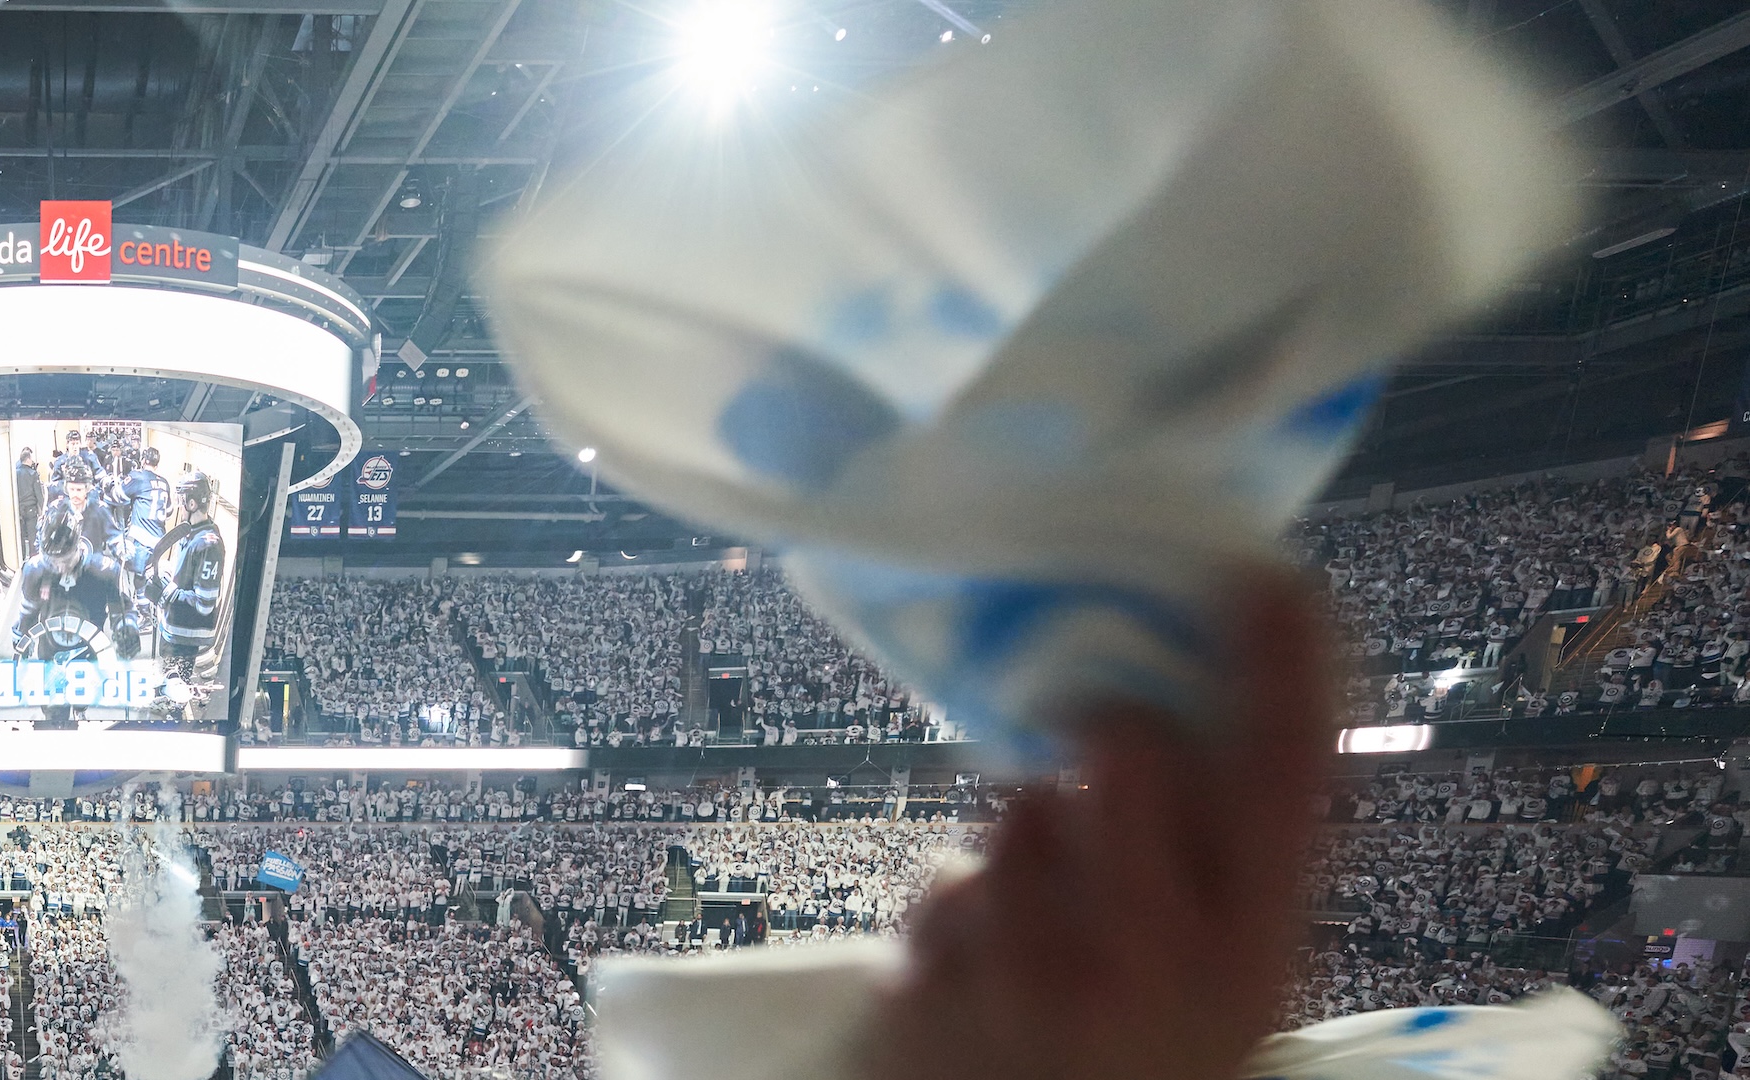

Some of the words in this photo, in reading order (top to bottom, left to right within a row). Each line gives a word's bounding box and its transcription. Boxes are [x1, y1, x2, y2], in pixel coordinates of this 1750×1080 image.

[40, 217, 112, 274] life
[119, 239, 212, 272] centre
[298, 494, 335, 502] NUMMINEN
[359, 494, 388, 503] SELANNE
[307, 505, 325, 521] 27
[367, 506, 383, 521] 13
[201, 561, 218, 580] 54
